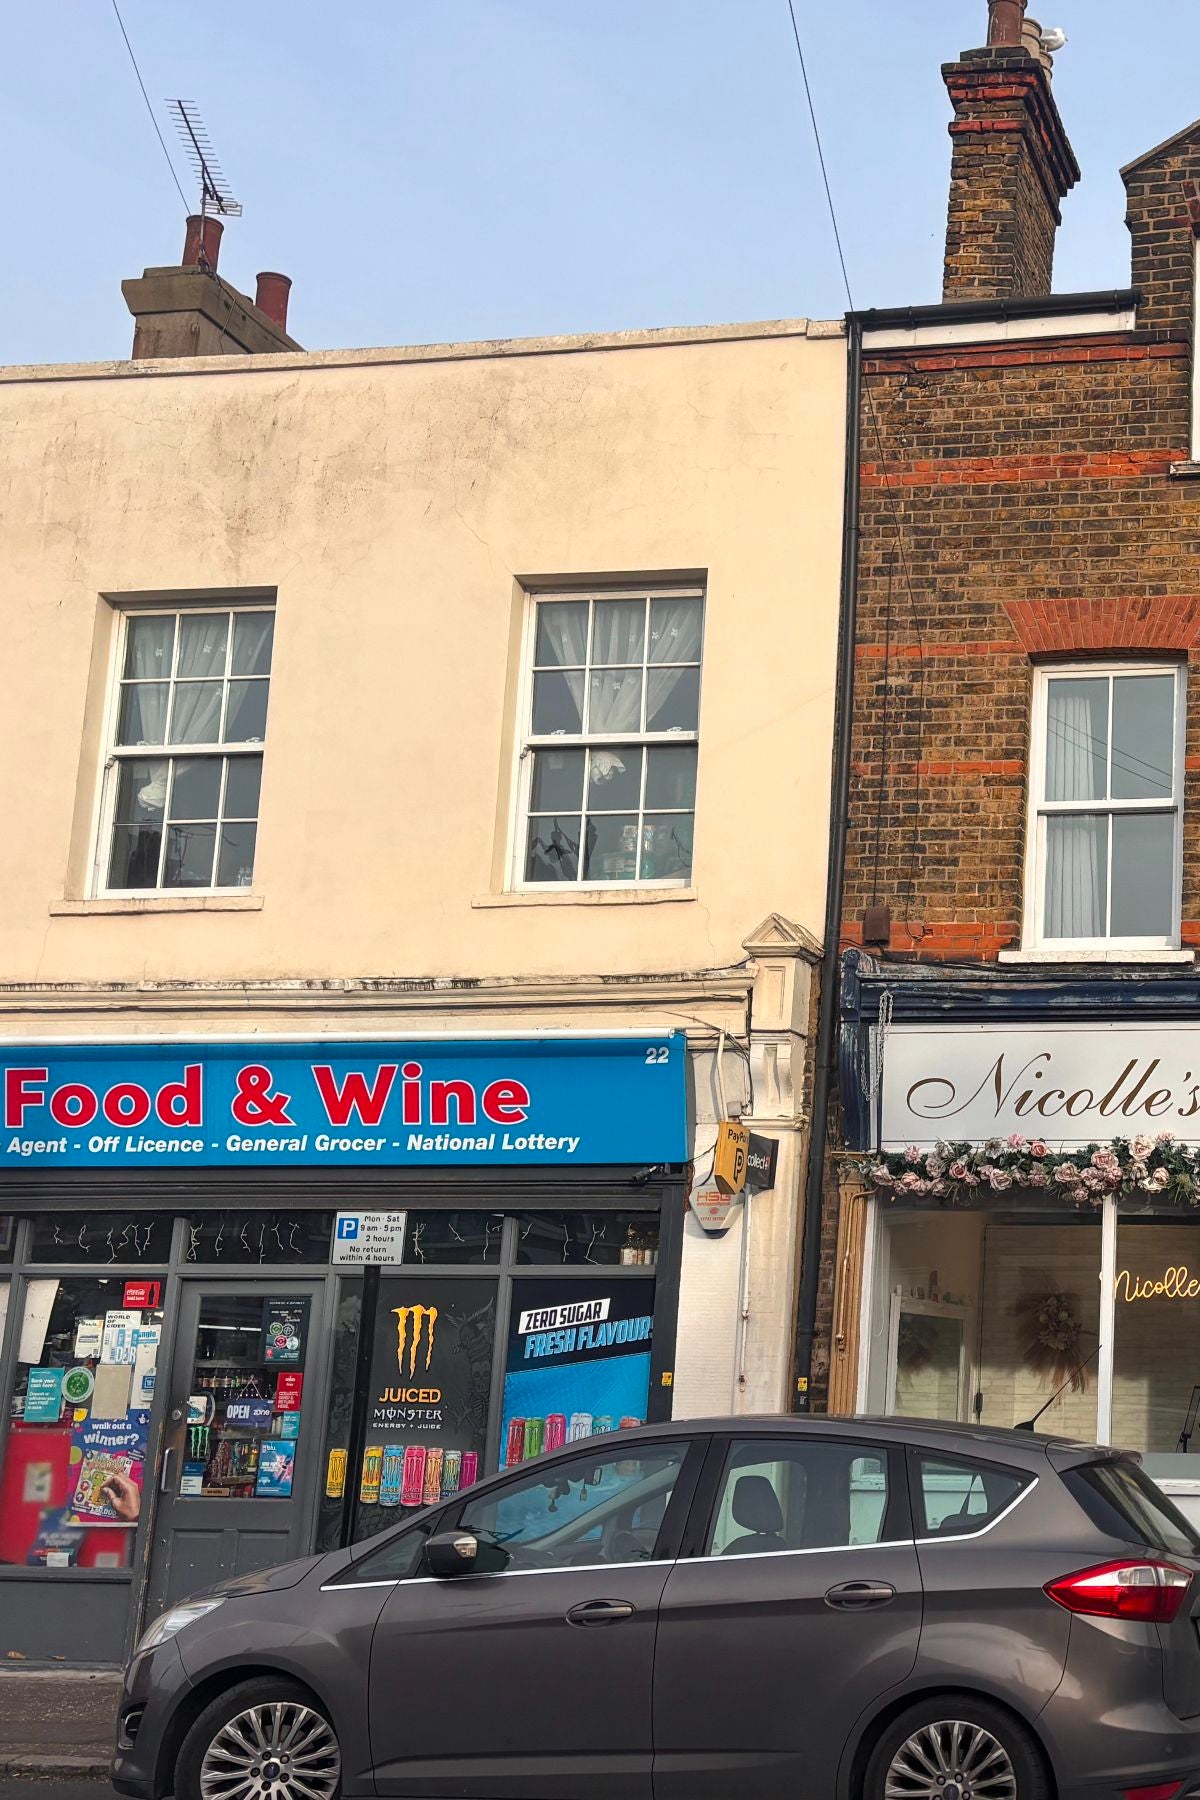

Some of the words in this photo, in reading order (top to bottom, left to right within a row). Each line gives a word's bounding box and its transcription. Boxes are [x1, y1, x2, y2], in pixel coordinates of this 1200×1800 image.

[645, 1047, 669, 1064] 22
[5, 1063, 203, 1128] Food
[231, 1064, 297, 1126] &
[311, 1061, 530, 1127] Wine
[6, 1136, 67, 1157] Agent
[88, 1135, 120, 1153] Off
[126, 1135, 203, 1152] Licence
[226, 1134, 307, 1152] General
[315, 1134, 386, 1151] Grocer
[407, 1133, 495, 1151] National
[502, 1132, 580, 1153] Lottery
[697, 1191, 731, 1202] HSG
[386, 1215, 400, 1223] Sat
[342, 1220, 355, 1237] P
[373, 1254, 395, 1262] hours
[525, 1309, 558, 1331] ZERO
[560, 1301, 603, 1325] SUGAR
[524, 1327, 577, 1359] FRESH
[379, 1387, 441, 1403] JUICED
[226, 1404, 250, 1418] OPEN
[374, 1406, 443, 1421] MONSTER
[91, 1422, 111, 1430] walk
[112, 1422, 125, 1430] out
[84, 1430, 139, 1446] winner?
